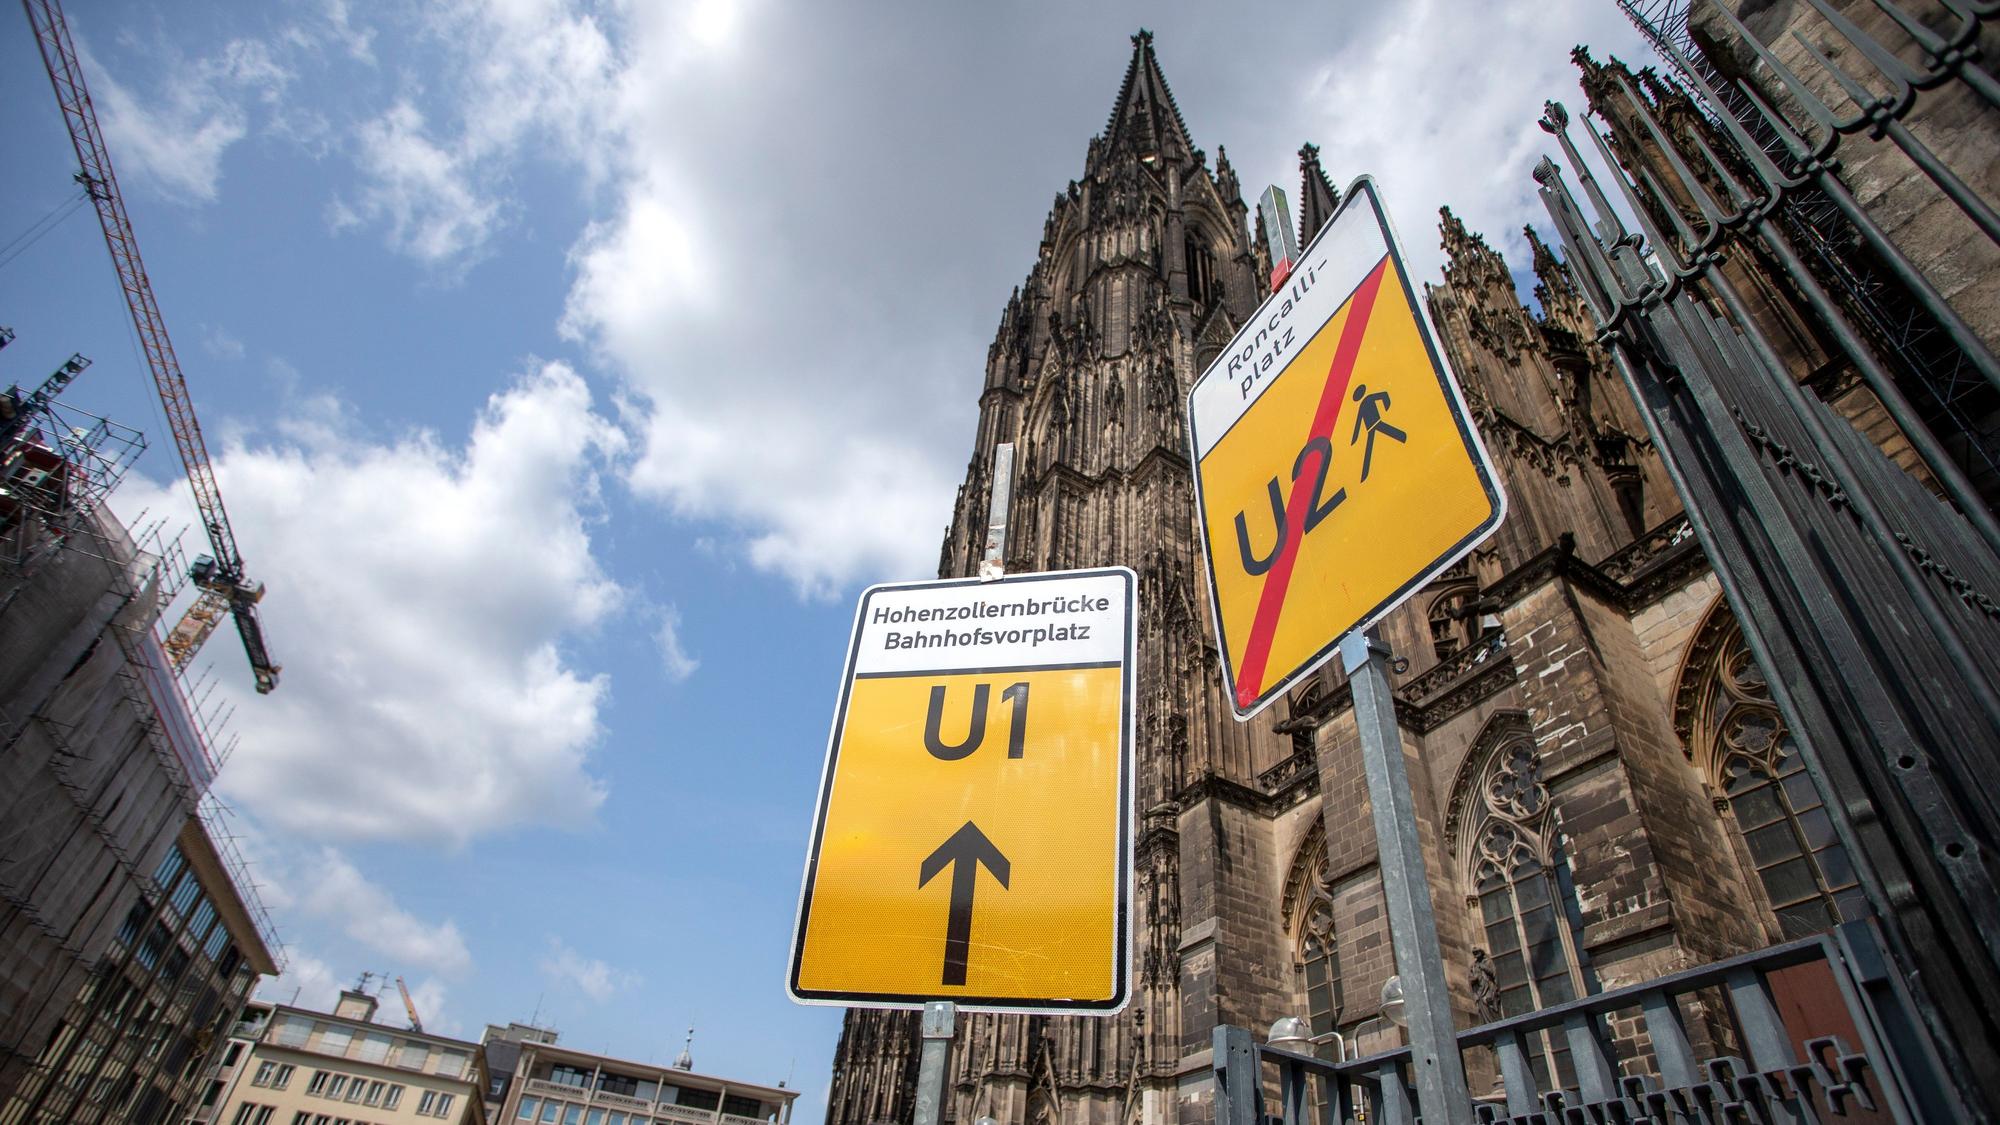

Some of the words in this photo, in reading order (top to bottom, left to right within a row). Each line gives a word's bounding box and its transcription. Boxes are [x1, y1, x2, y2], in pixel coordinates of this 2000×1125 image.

[1227, 259, 1327, 380] Roncalli-
[1240, 326, 1295, 400] platz
[1234, 436, 1347, 576] U2
[872, 595, 1109, 624] Hohenzollernbrücke
[884, 623, 1090, 650] Bahnhofsvorplatz
[924, 682, 1030, 761] U1
